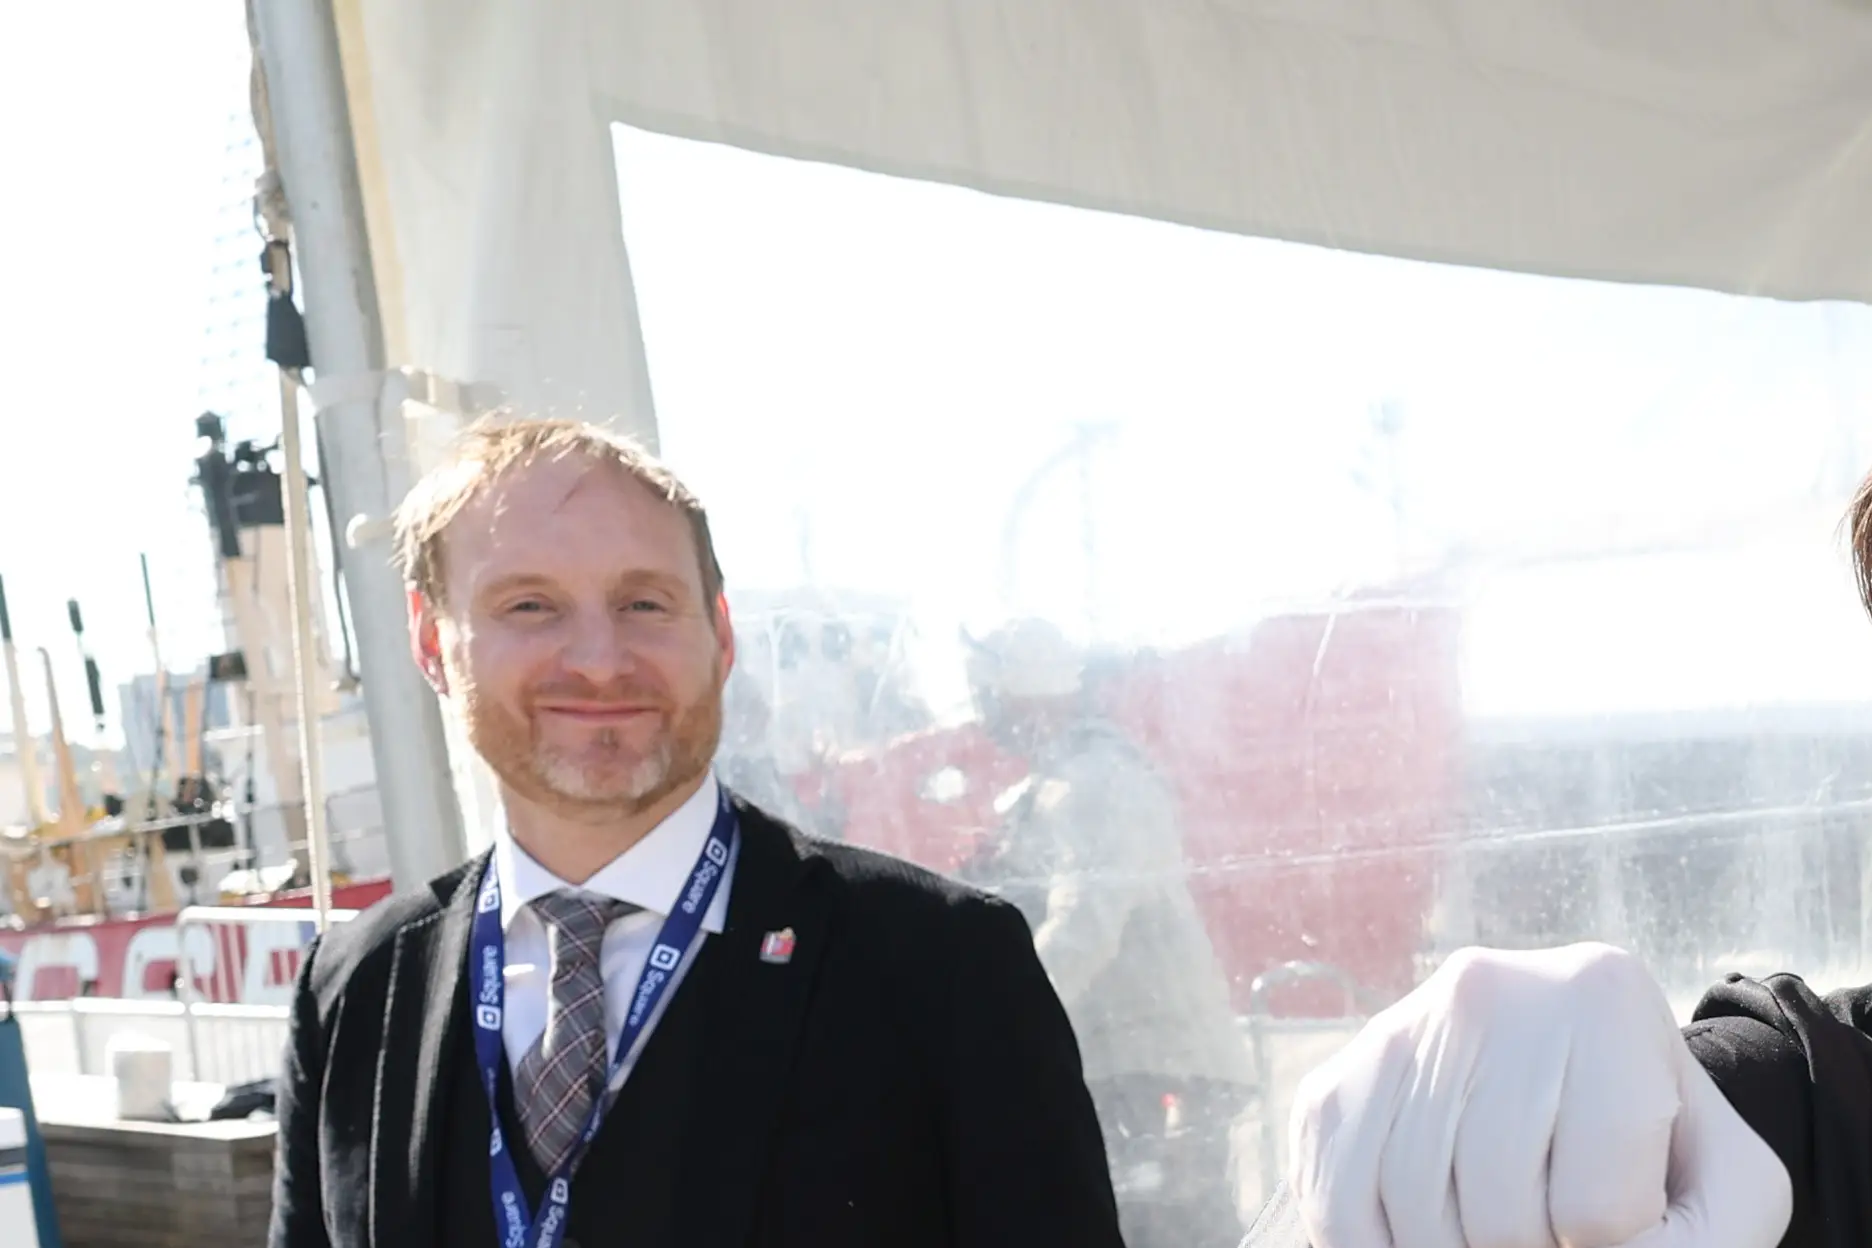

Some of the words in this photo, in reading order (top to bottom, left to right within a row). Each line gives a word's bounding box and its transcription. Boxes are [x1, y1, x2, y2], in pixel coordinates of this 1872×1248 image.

[682, 860, 718, 914] Square
[479, 945, 502, 1005] Square
[628, 969, 665, 1026] Square
